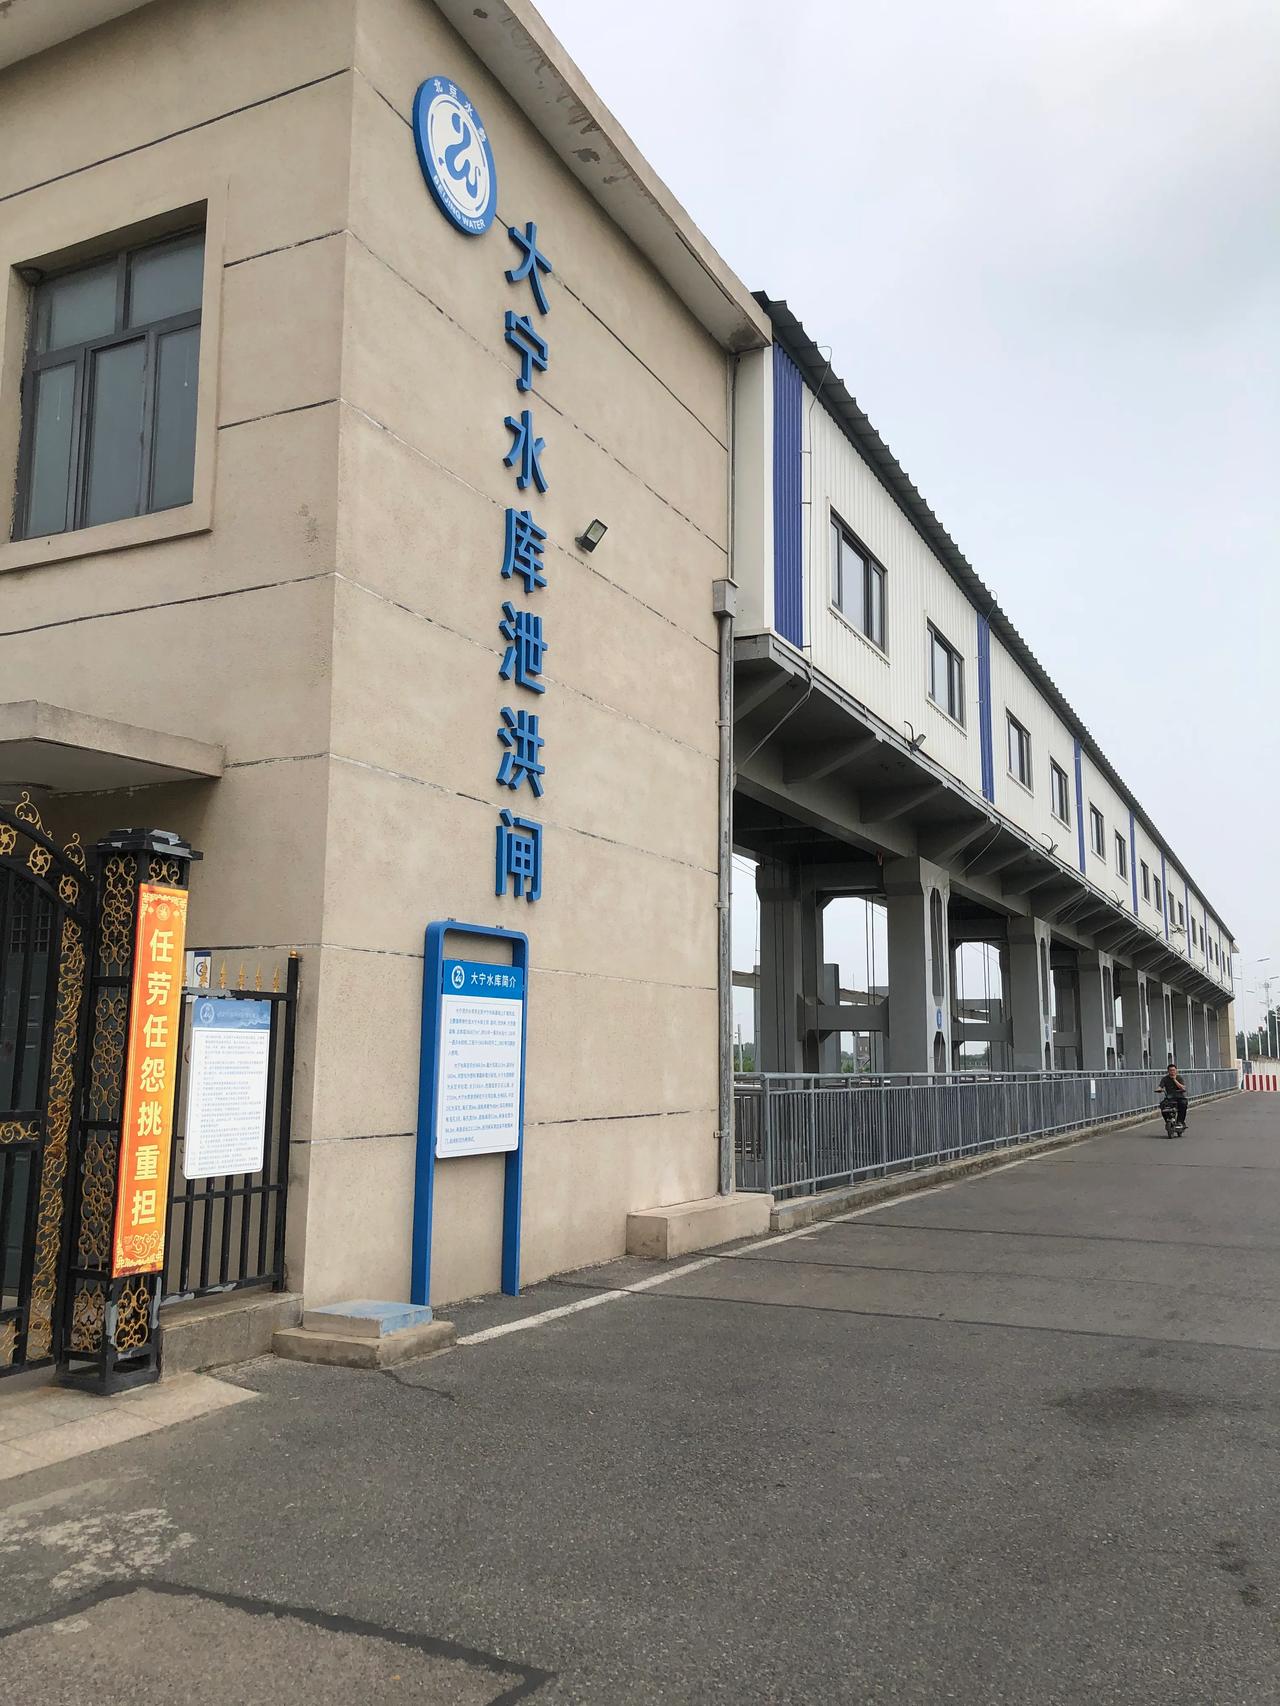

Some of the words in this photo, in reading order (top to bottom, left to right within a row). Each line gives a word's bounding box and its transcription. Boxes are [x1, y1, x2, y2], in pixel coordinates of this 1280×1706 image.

[433, 174, 461, 219] BEIJING
[461, 215, 486, 230] WATER
[496, 221, 552, 902] 大宁水库泄洪闸
[470, 971, 517, 988] 大宁水库简介
[131, 928, 175, 1226] 任劳任怨挑重担
